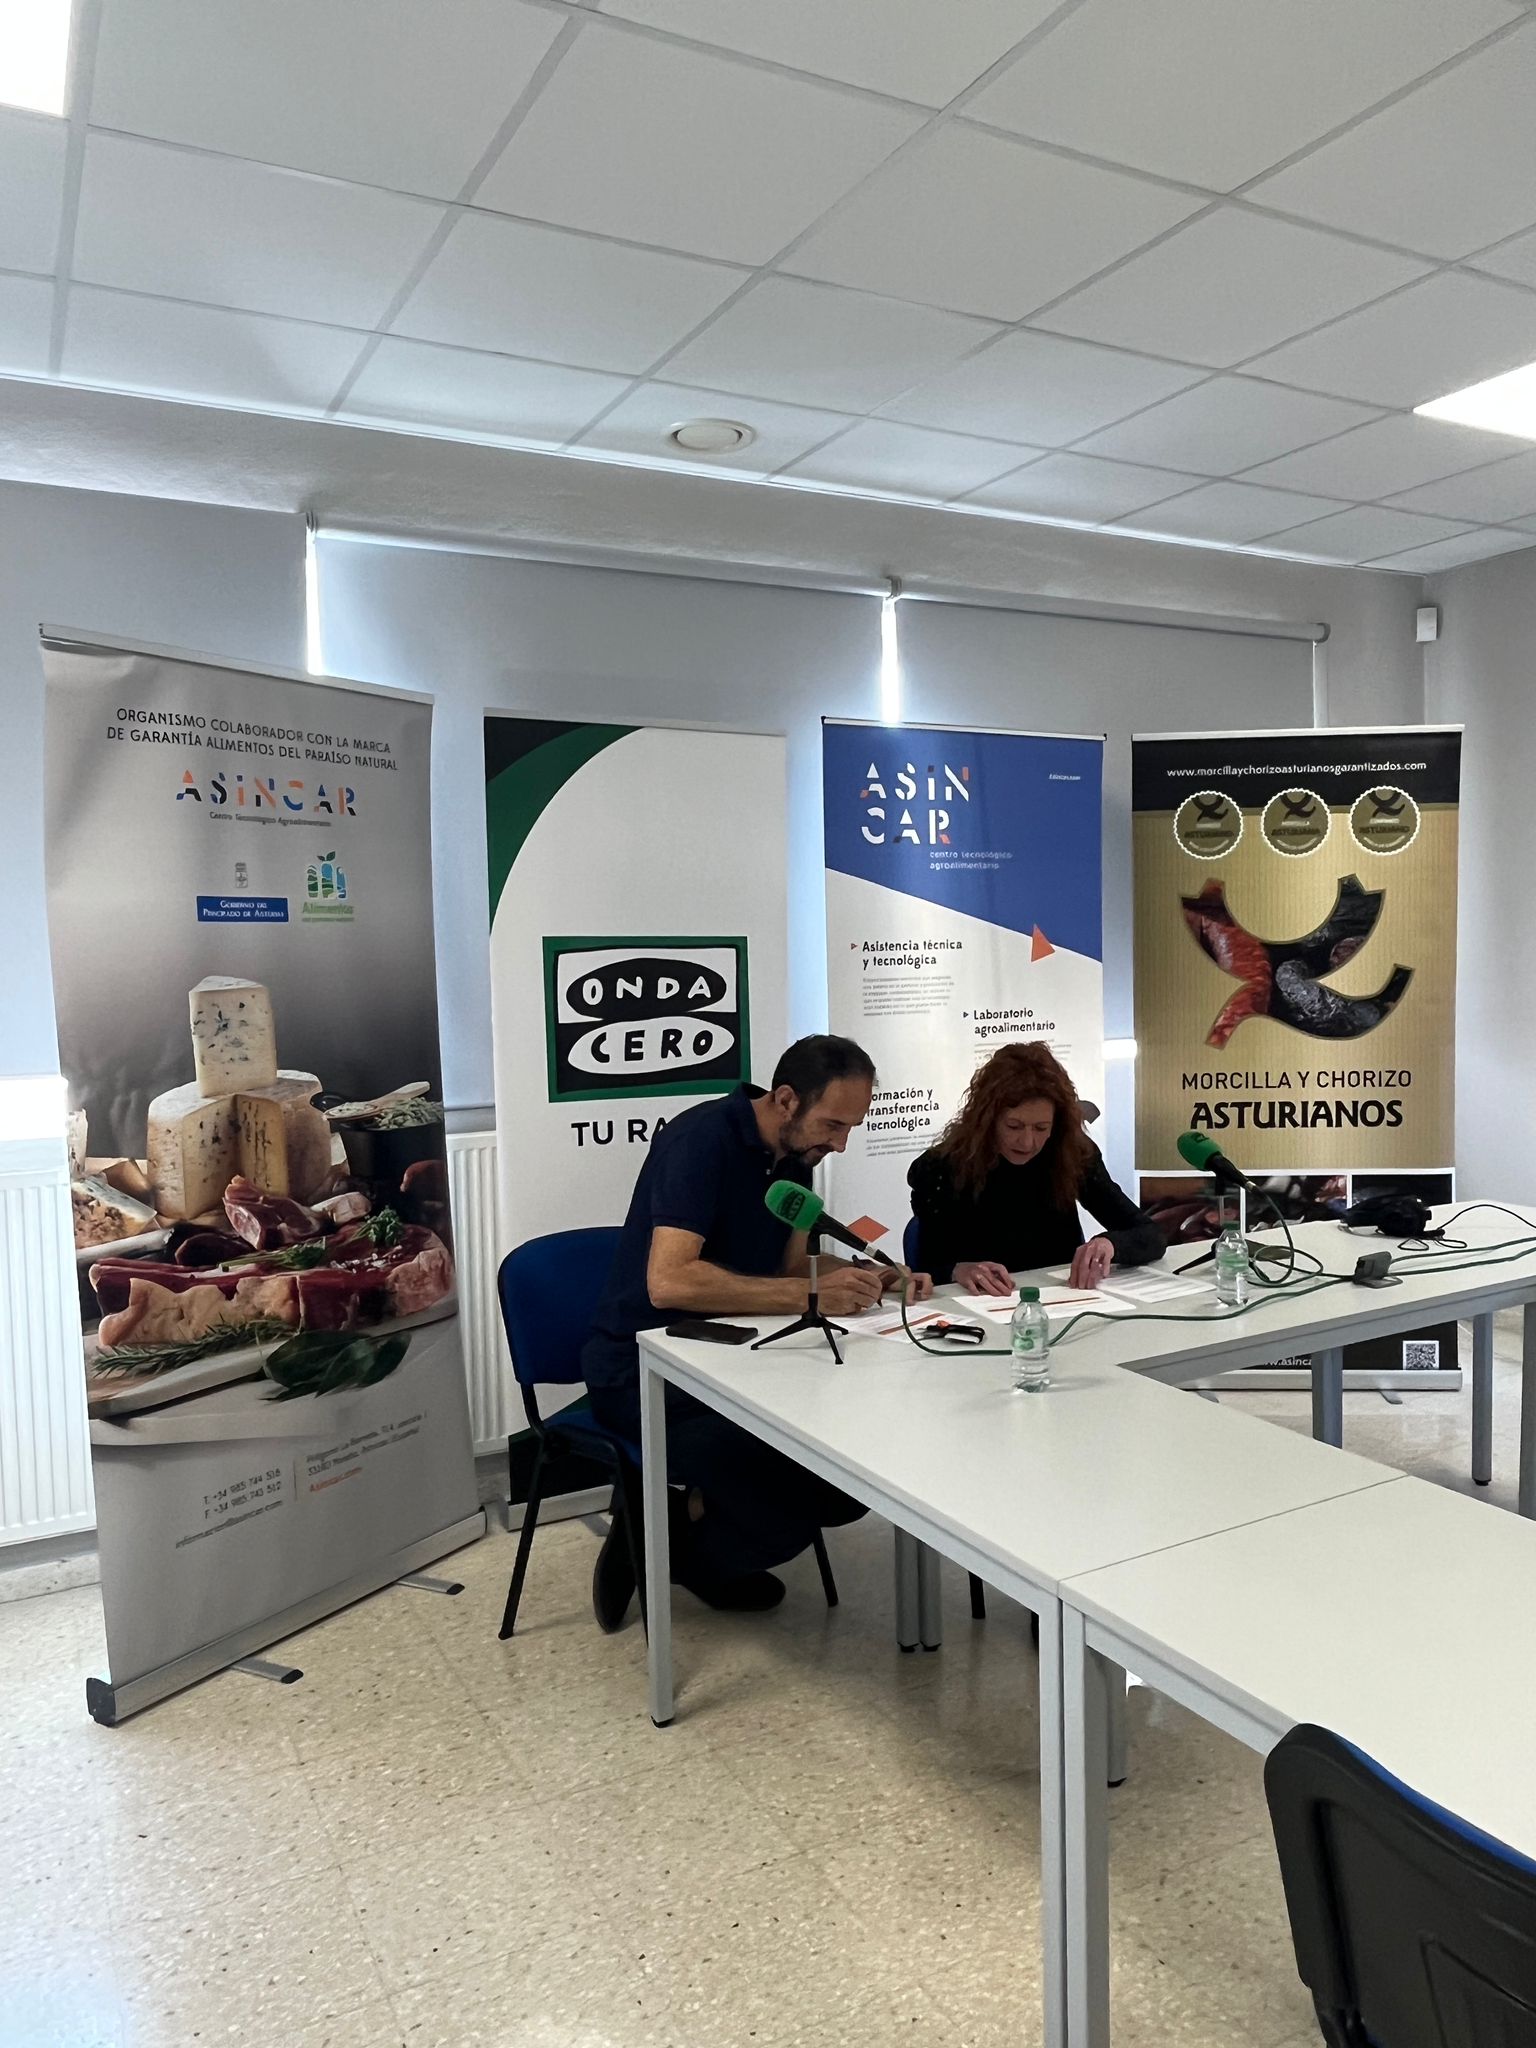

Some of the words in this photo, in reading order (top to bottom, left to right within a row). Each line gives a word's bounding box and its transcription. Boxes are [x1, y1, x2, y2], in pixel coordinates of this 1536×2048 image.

[116, 708, 206, 728] ORGANISMO
[211, 718, 304, 742] COLABORADOR
[306, 732, 332, 746] CON
[336, 736, 349, 748] LA
[353, 738, 392, 754] MARCA
[106, 726, 125, 741] DE
[130, 729, 202, 747] GARANTÍA
[206, 736, 275, 756] ALIMENTOS
[279, 746, 301, 759] DEL
[305, 749, 351, 766] PARAÍSO
[355, 756, 399, 771] NATURAL
[1166, 761, 1427, 777] www.morcillaychorizoasturianosgarantizados.com
[861, 806, 952, 845] CAR
[929, 851, 959, 859] centro
[929, 862, 1000, 871] agroalimentario
[862, 940, 920, 953] Asistencia
[923, 939, 963, 951] técnica
[862, 957, 869, 970] y
[873, 954, 937, 969] tecnológica
[582, 976, 712, 1006] ONDA
[974, 1007, 1034, 1021] Laboratorio
[974, 1022, 1056, 1038] agroalimentario
[590, 1028, 714, 1063] CERO
[1181, 1071, 1292, 1090] MORCILLA
[1297, 1070, 1310, 1088] Y
[1316, 1069, 1412, 1088] CHORIZO
[871, 1087, 924, 1101] ormación
[926, 1089, 933, 1100] y
[1190, 1100, 1403, 1129] ASTURIANOS
[867, 1116, 931, 1132] tecnológica
[571, 1120, 614, 1147] TU
